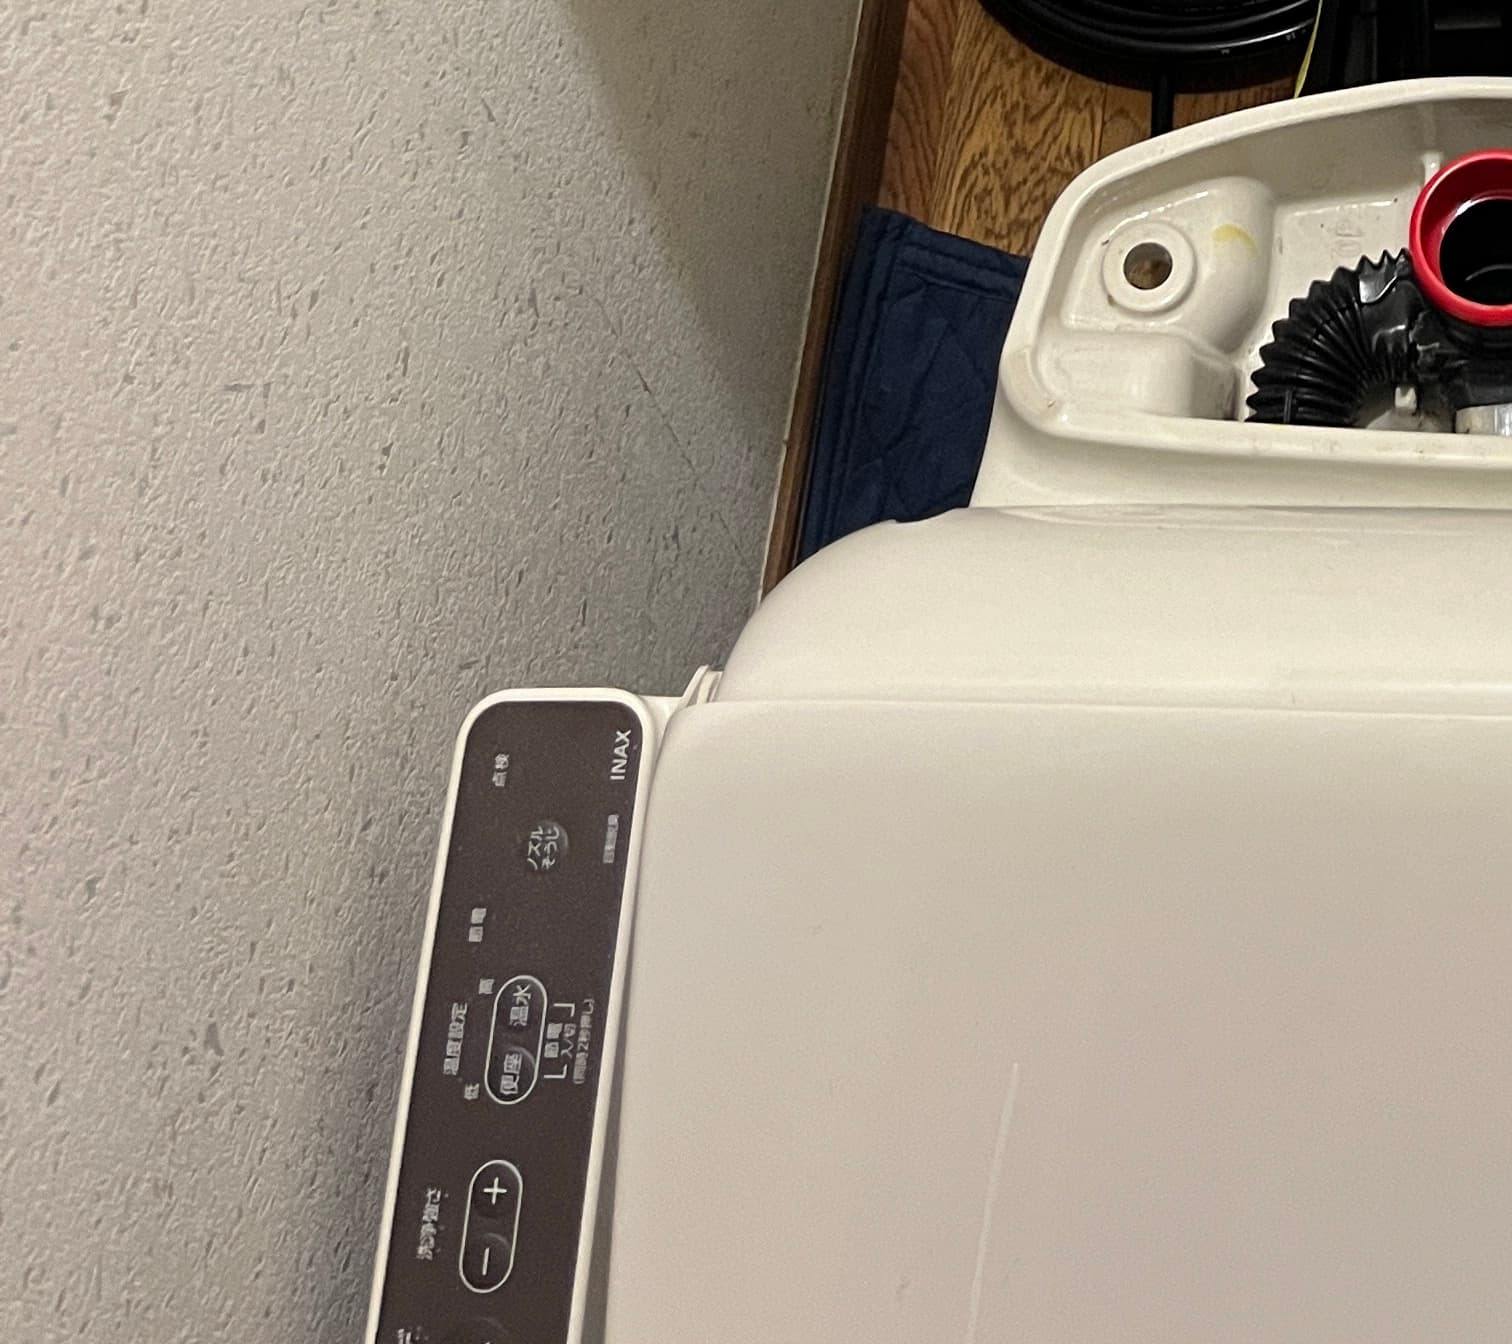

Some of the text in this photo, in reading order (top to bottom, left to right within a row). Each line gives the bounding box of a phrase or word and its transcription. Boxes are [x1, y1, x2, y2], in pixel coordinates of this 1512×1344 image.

[609, 729, 630, 780] INAX
[526, 825, 542, 870] ノズル
[541, 825, 558, 869] そうじ
[509, 984, 530, 1026] 温水
[499, 1052, 521, 1095] 便座
